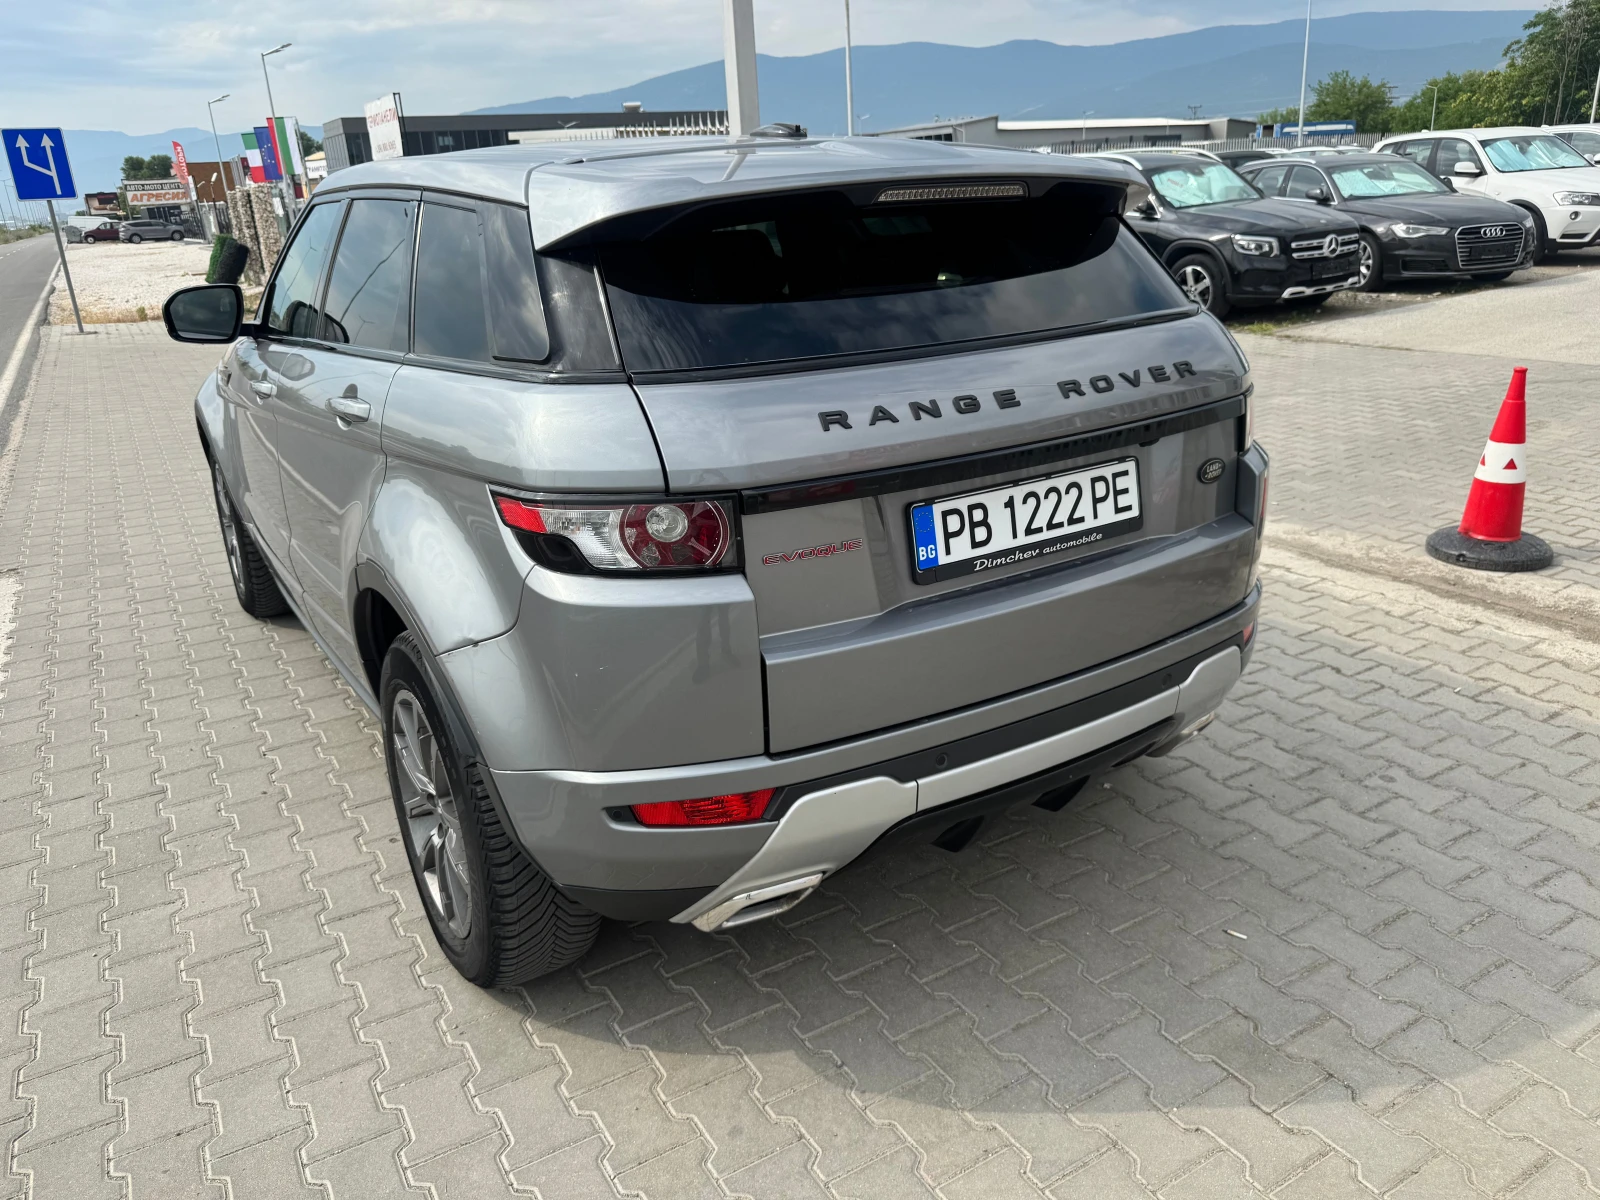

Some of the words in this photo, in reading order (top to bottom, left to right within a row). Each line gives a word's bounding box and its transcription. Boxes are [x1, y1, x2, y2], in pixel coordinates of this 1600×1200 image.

[130, 191, 189, 203] АГРЕСИЯ
[162, 182, 184, 190] ЦЕНТЪ
[818, 388, 1021, 432] RANGE
[1056, 360, 1198, 399] ROVER
[941, 502, 993, 556] PB
[1003, 481, 1086, 540] 1222
[1090, 470, 1133, 520] PE
[763, 538, 863, 566] EVOQUE
[918, 544, 936, 561] BG
[973, 548, 1040, 571] Dimchev
[1042, 532, 1103, 554] automobile
